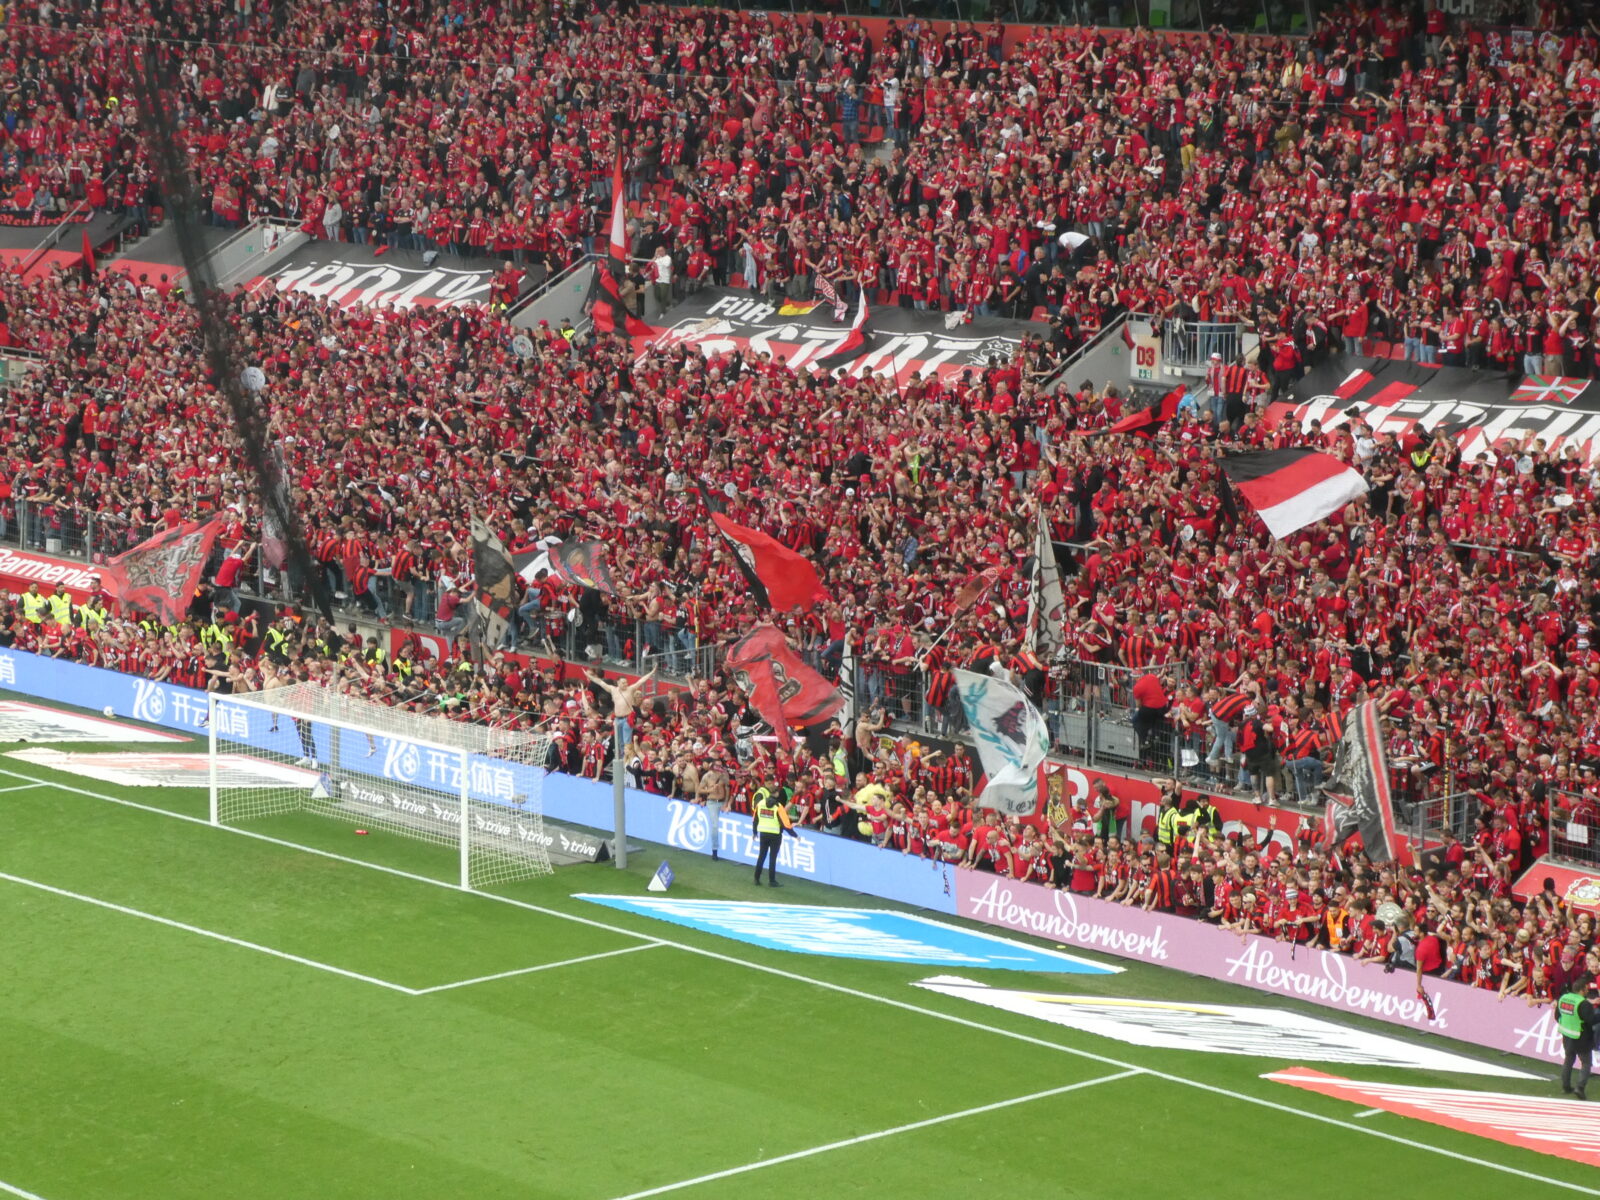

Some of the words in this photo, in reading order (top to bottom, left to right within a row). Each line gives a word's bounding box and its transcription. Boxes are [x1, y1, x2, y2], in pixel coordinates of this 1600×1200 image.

[706, 296, 776, 323] FÜR
[1136, 345, 1155, 367] D3
[442, 808, 462, 823] triv
[570, 840, 597, 857] trive
[970, 879, 1169, 961] Alexanderwerk
[1225, 939, 1449, 1030] Alexanderwerk
